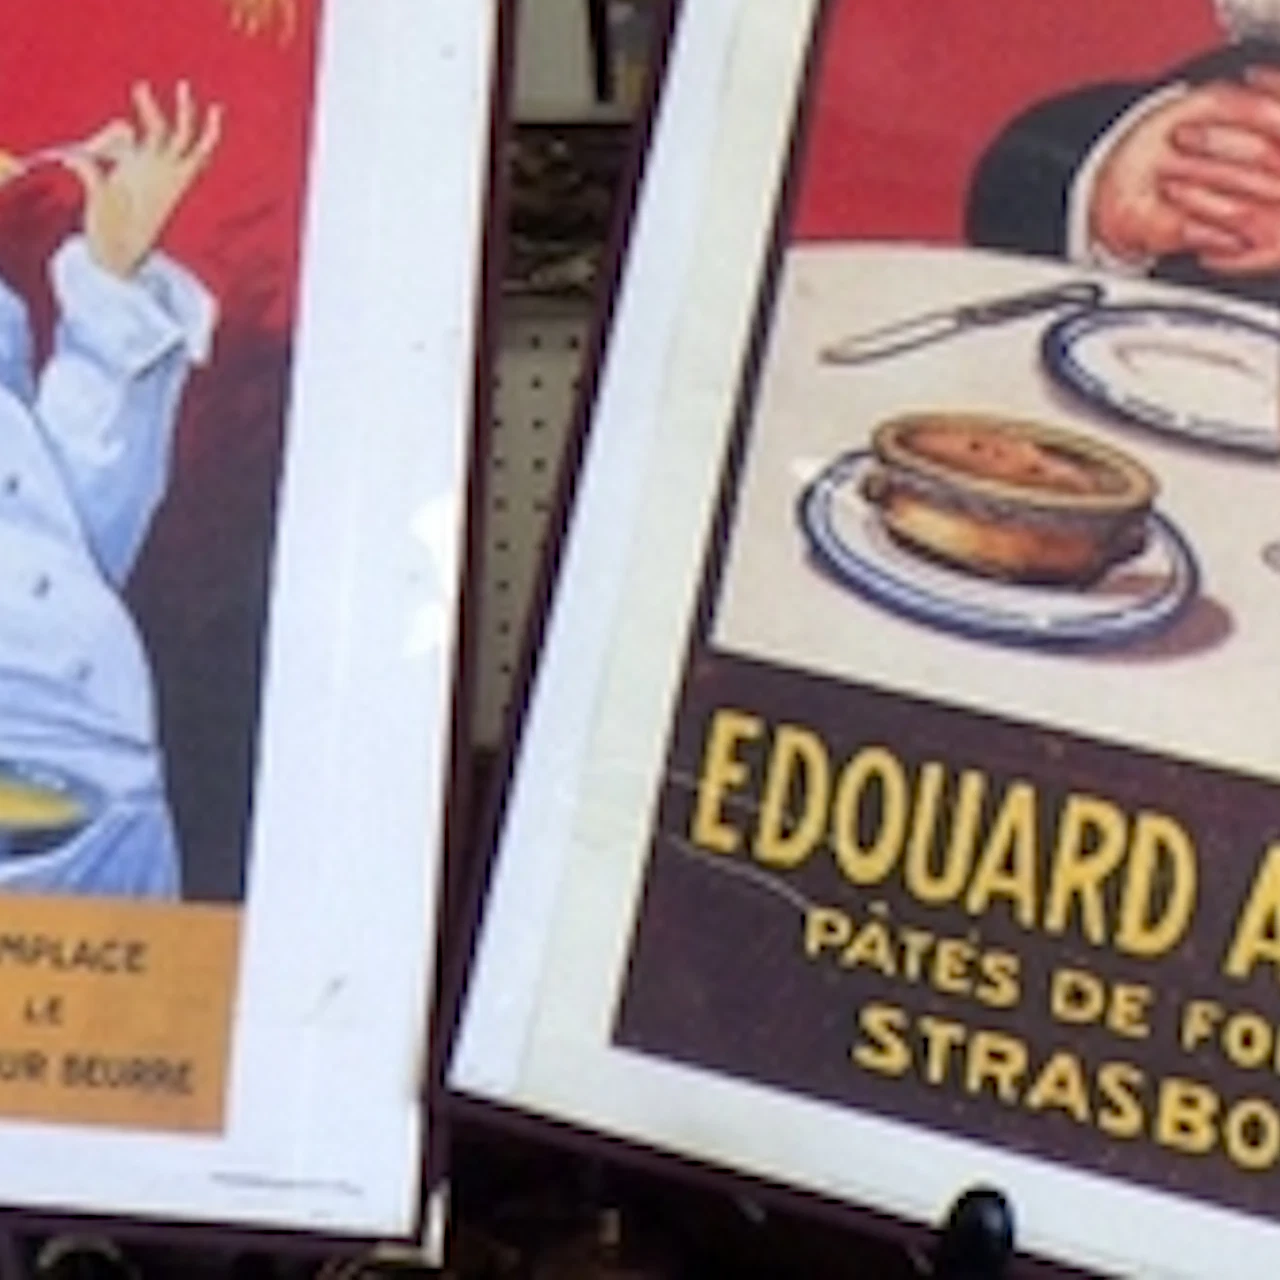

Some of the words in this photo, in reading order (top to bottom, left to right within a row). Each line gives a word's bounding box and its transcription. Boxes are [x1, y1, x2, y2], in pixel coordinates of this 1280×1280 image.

[692, 710, 1198, 954] EDOUARD
[22, 994, 65, 1027] LE
[1050, 965, 1151, 1039] DE
[61, 1052, 195, 1096] BEURRE
